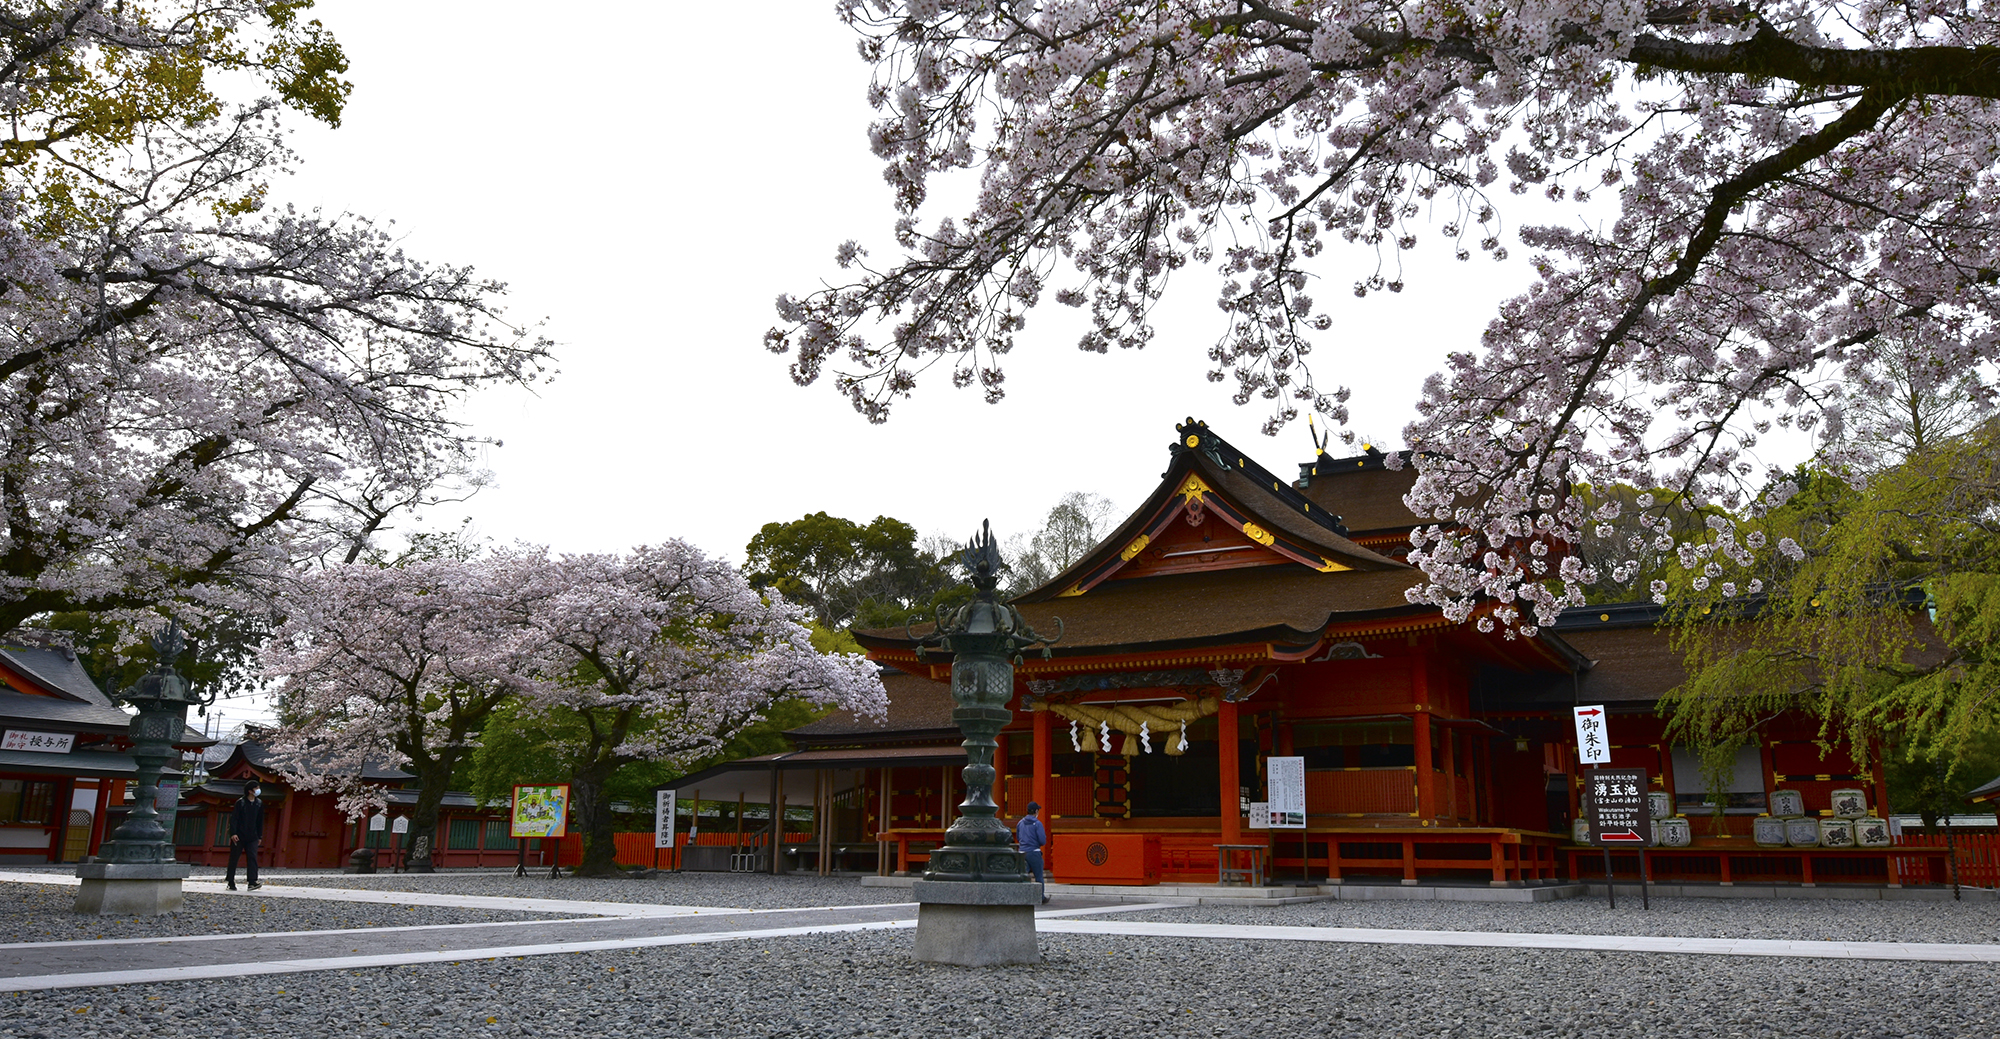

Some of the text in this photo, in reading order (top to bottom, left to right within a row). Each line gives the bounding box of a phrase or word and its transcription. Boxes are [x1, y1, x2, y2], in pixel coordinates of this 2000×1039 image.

[30, 735, 68, 748] 授与所
[1581, 718, 1602, 760] 御朱印
[1594, 783, 1638, 796] 湧玉池
